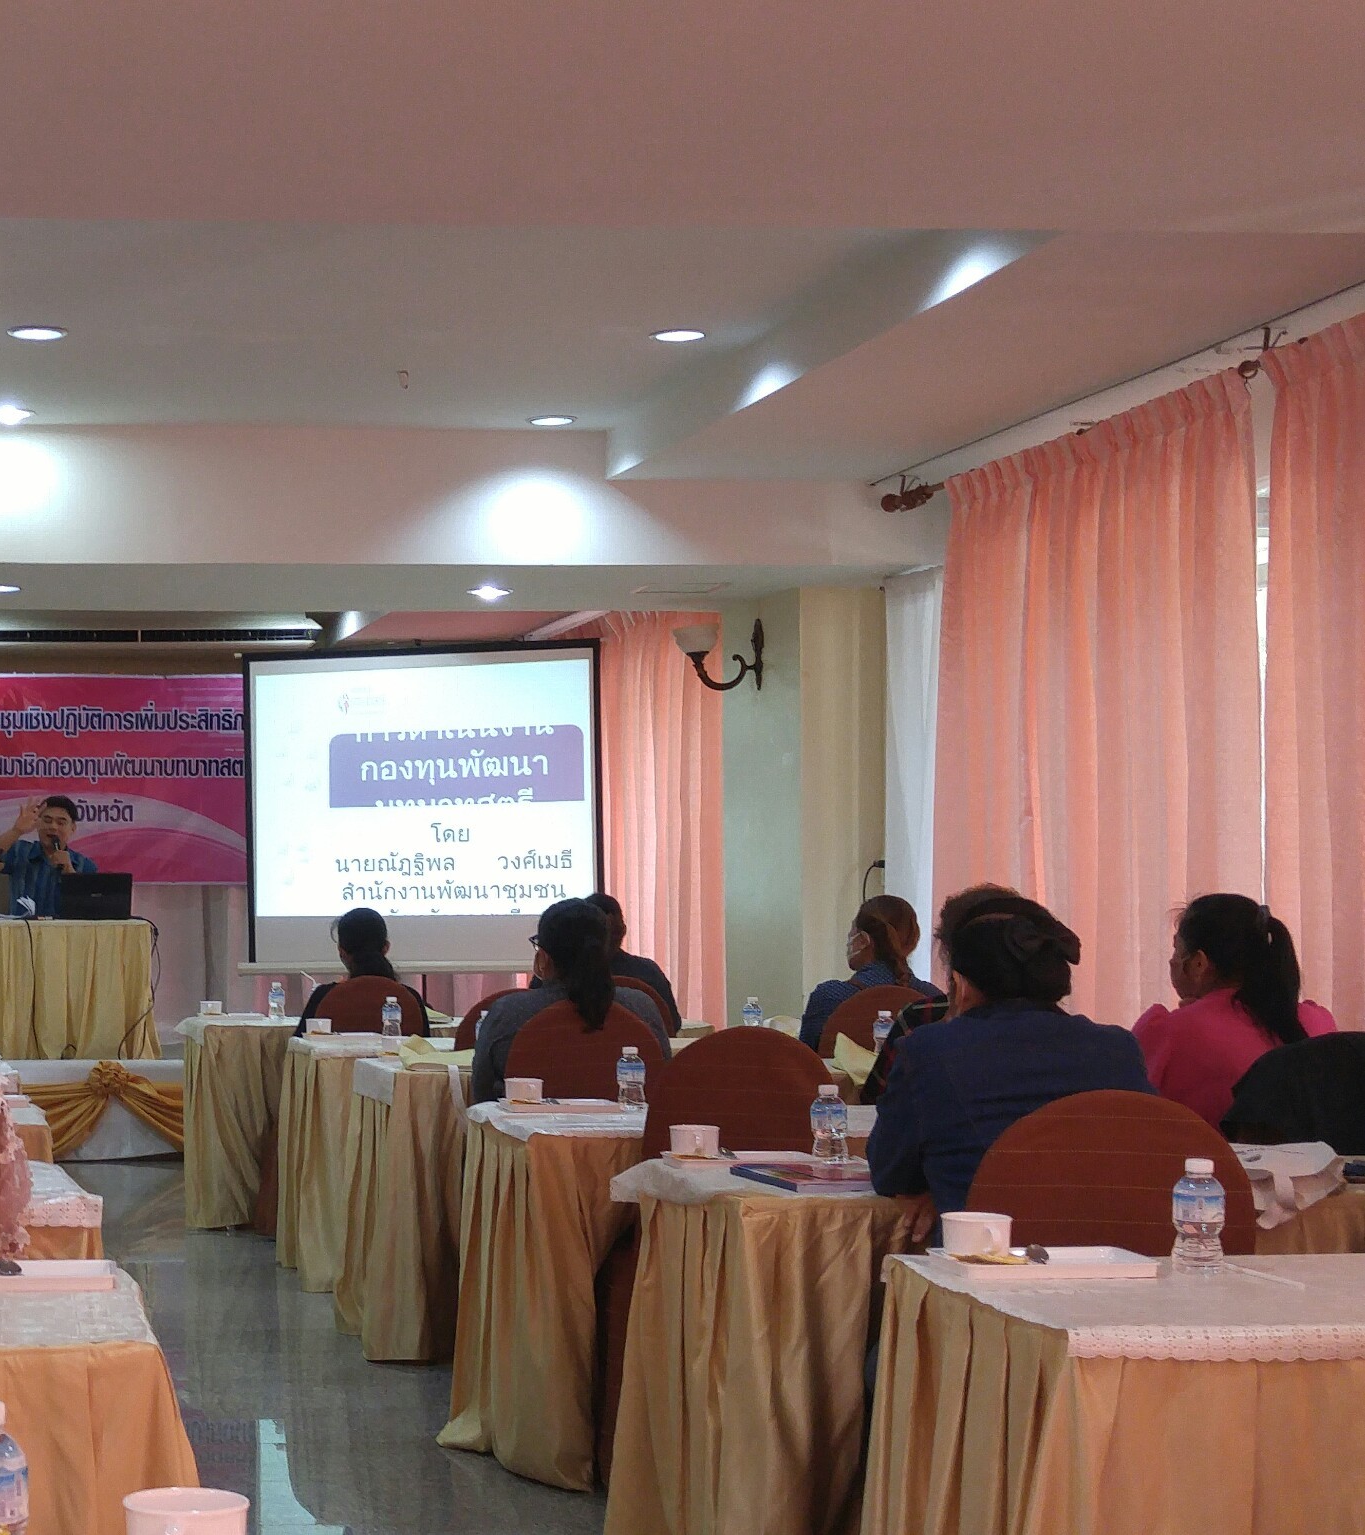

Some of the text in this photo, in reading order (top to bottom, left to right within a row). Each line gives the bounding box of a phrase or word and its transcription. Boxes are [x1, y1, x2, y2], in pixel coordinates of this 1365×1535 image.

[360, 748, 550, 785] กองทุนพัฒนา
[430, 822, 470, 843] โดย
[497, 848, 573, 870] วงศ์เมธี
[341, 879, 567, 904] สำนักงานพัฒนาชุมชน
